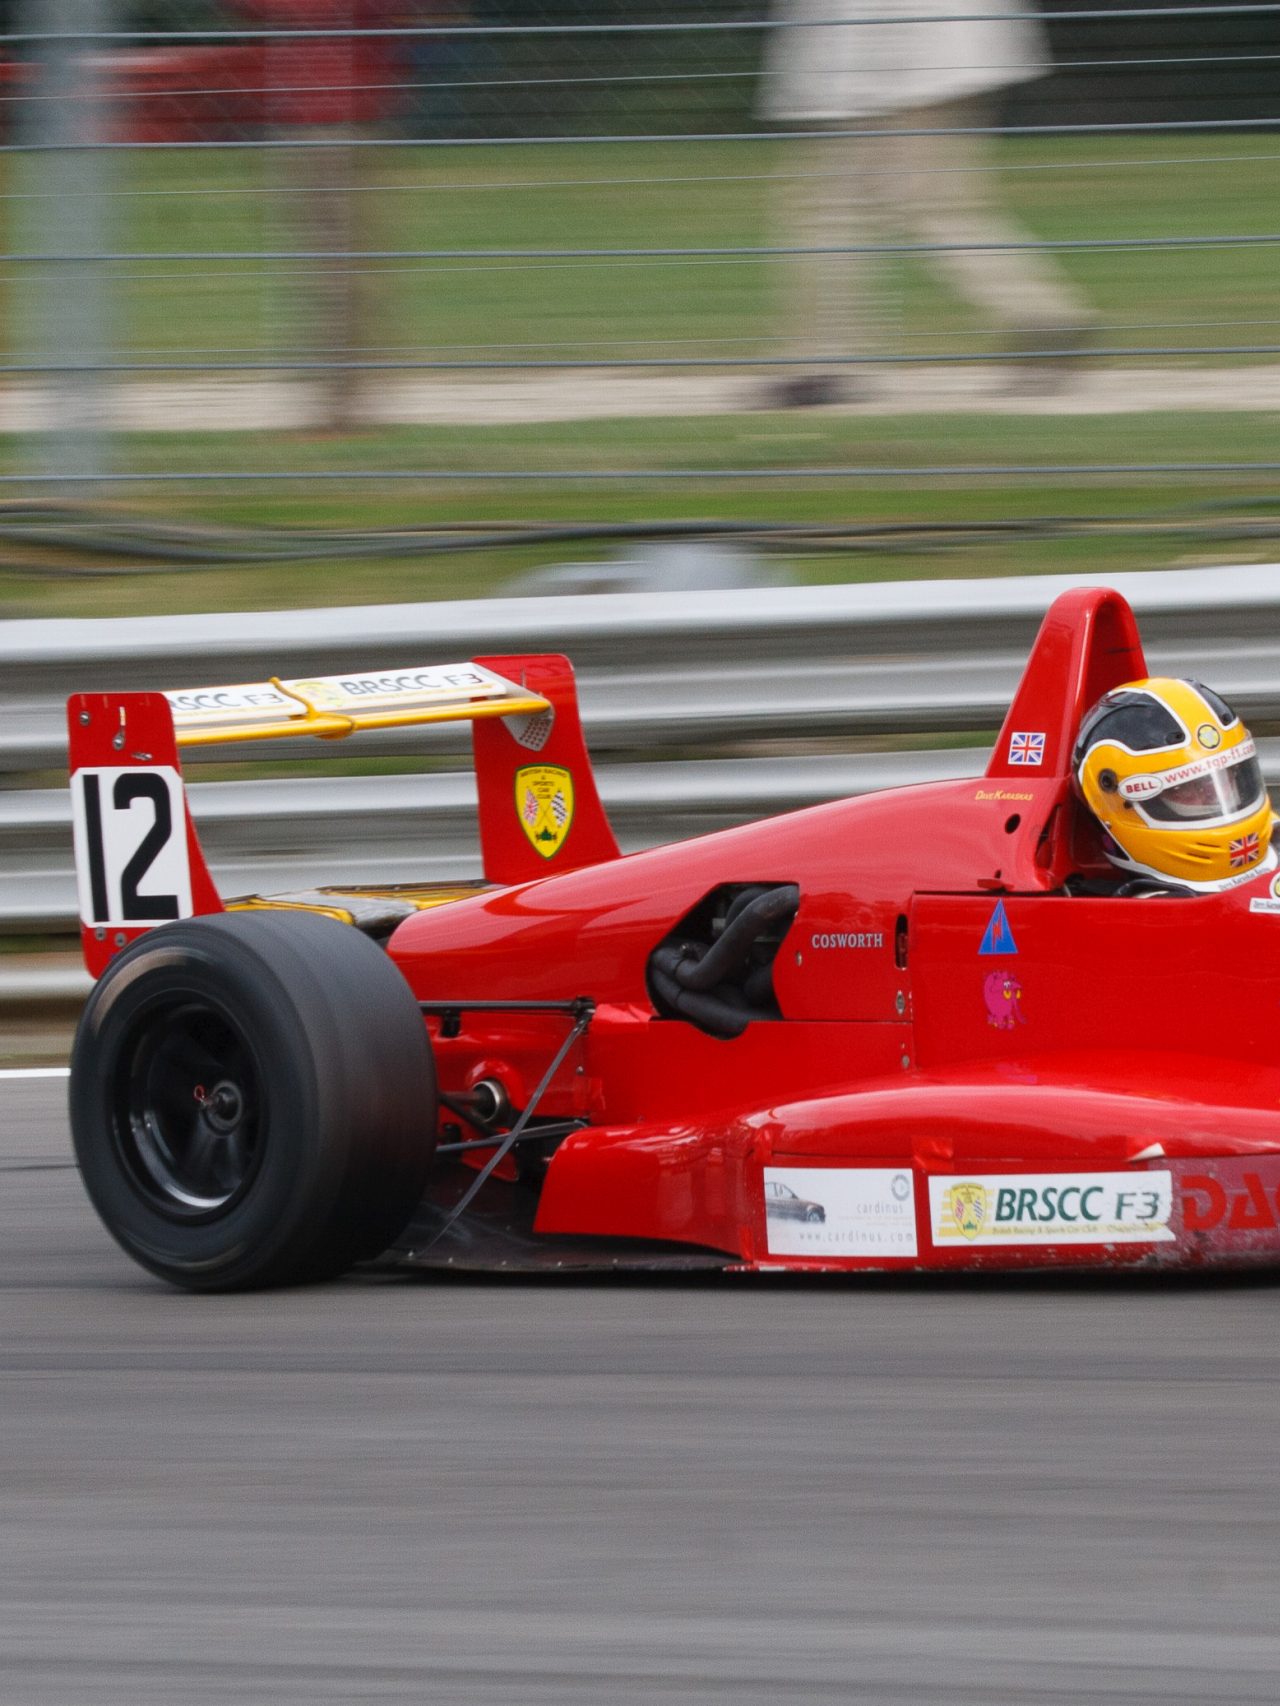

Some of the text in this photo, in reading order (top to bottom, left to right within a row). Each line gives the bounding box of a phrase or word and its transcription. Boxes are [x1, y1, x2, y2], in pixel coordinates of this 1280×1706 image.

[340, 673, 441, 697] BRSCC
[443, 672, 485, 687] F3
[243, 692, 285, 706] F3
[1125, 780, 1157, 794] BELL
[83, 772, 180, 922] 12
[811, 932, 884, 949] COSWORTH
[856, 1201, 904, 1215] cardinus
[994, 1185, 1105, 1223] BRSCC
[1114, 1191, 1162, 1221] F3
[799, 1230, 914, 1243] www.cardinus.com
